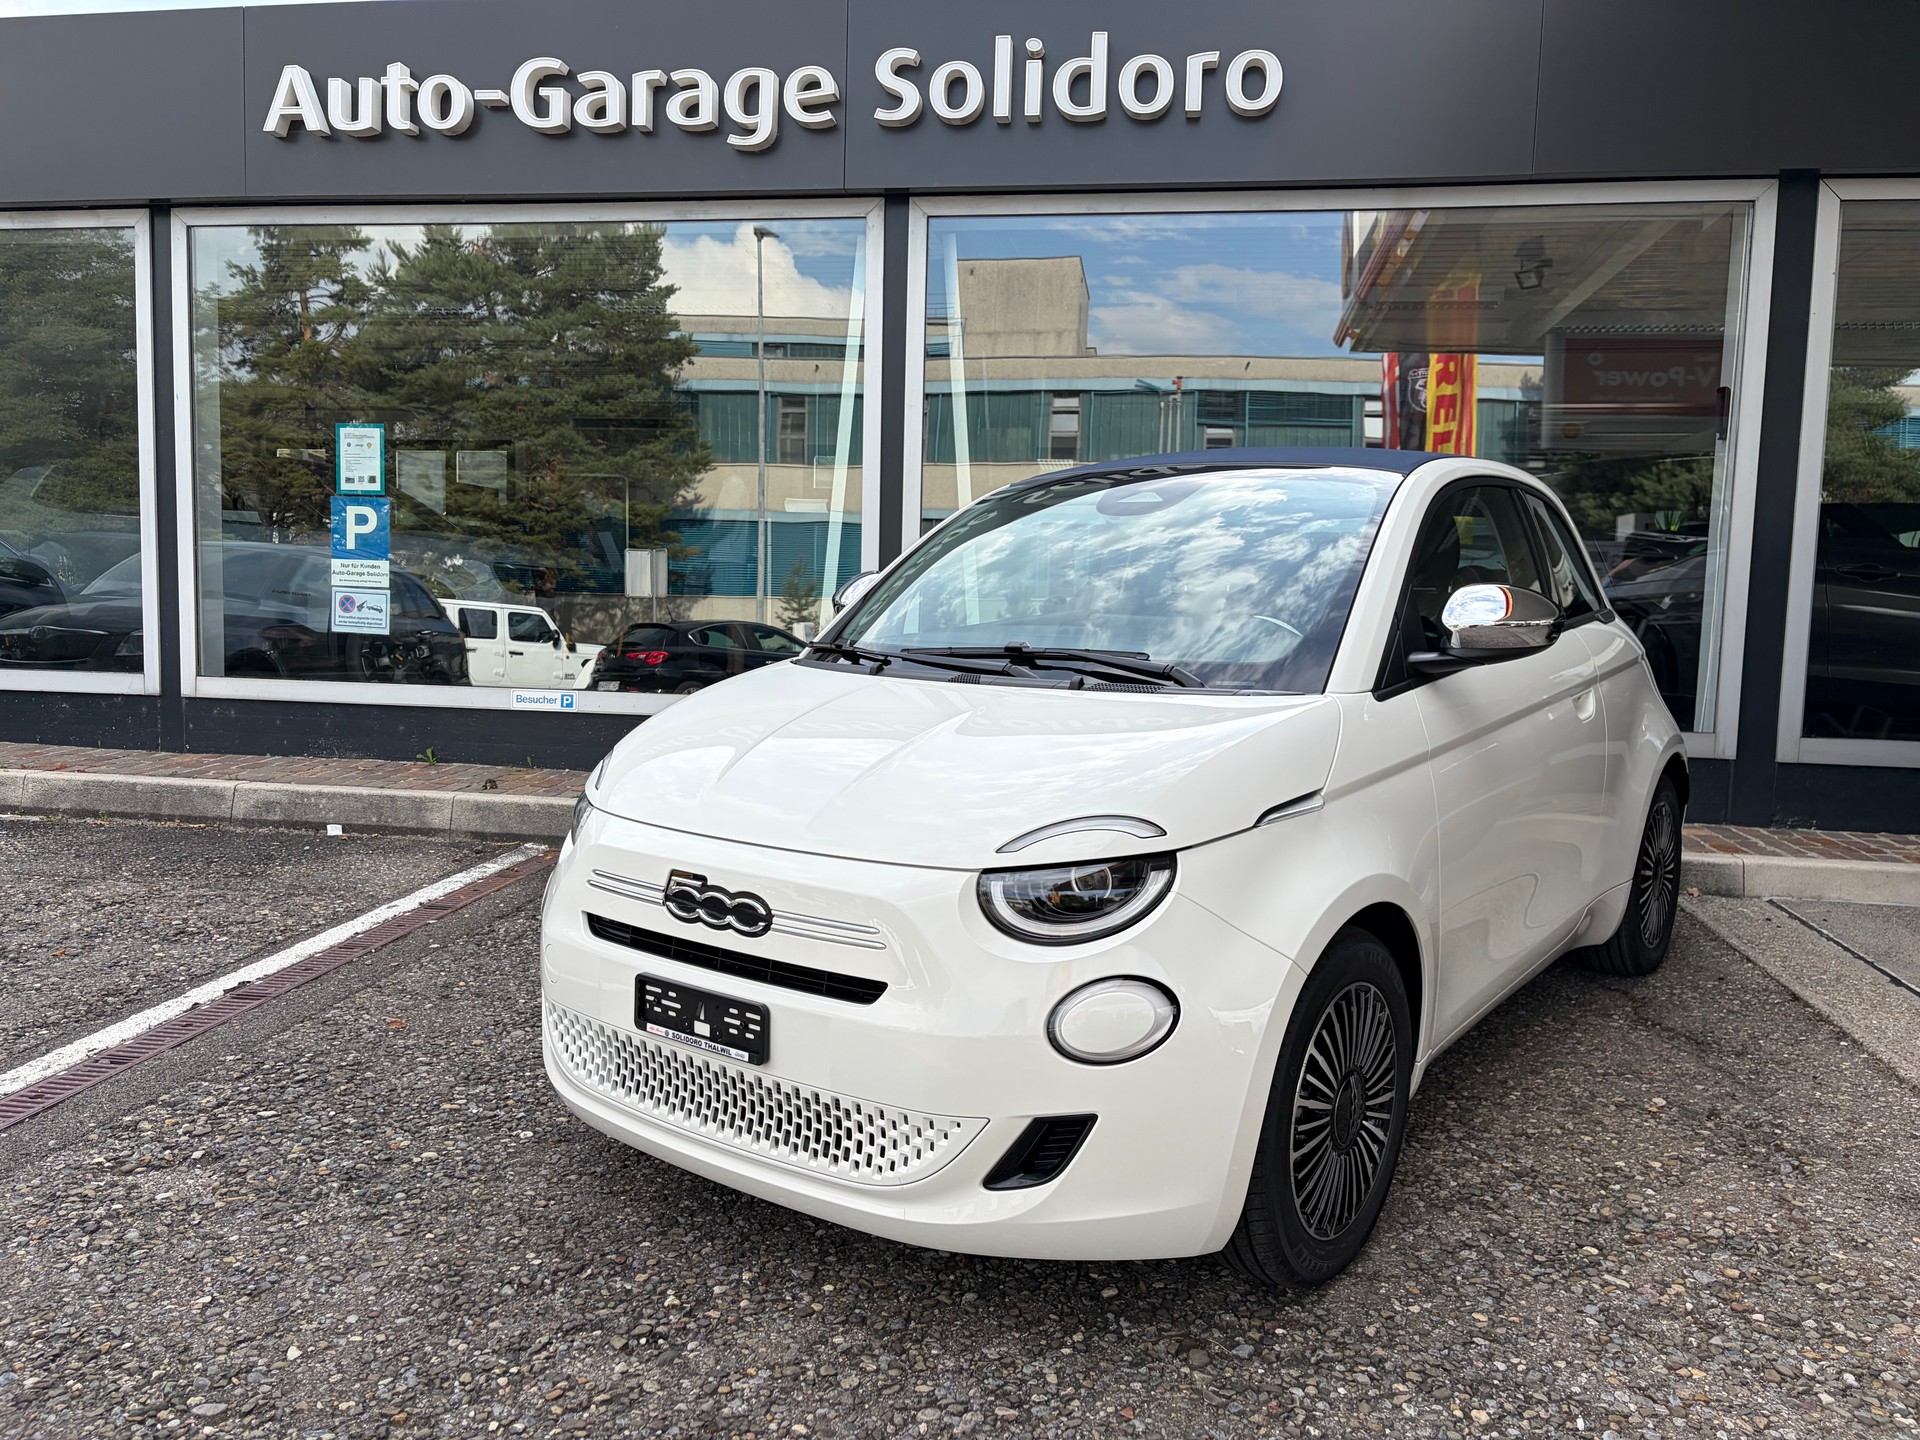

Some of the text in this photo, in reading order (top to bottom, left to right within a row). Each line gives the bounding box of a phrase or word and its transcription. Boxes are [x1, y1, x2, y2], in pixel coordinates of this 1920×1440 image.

[263, 31, 1284, 152] Auto-Garage Solidoro
[346, 506, 378, 549] P
[332, 569, 366, 577] Auto-Garage
[516, 694, 572, 707] Besucher P
[665, 870, 772, 938] 500
[671, 1032, 732, 1056] SOLIDORO THALWIL
